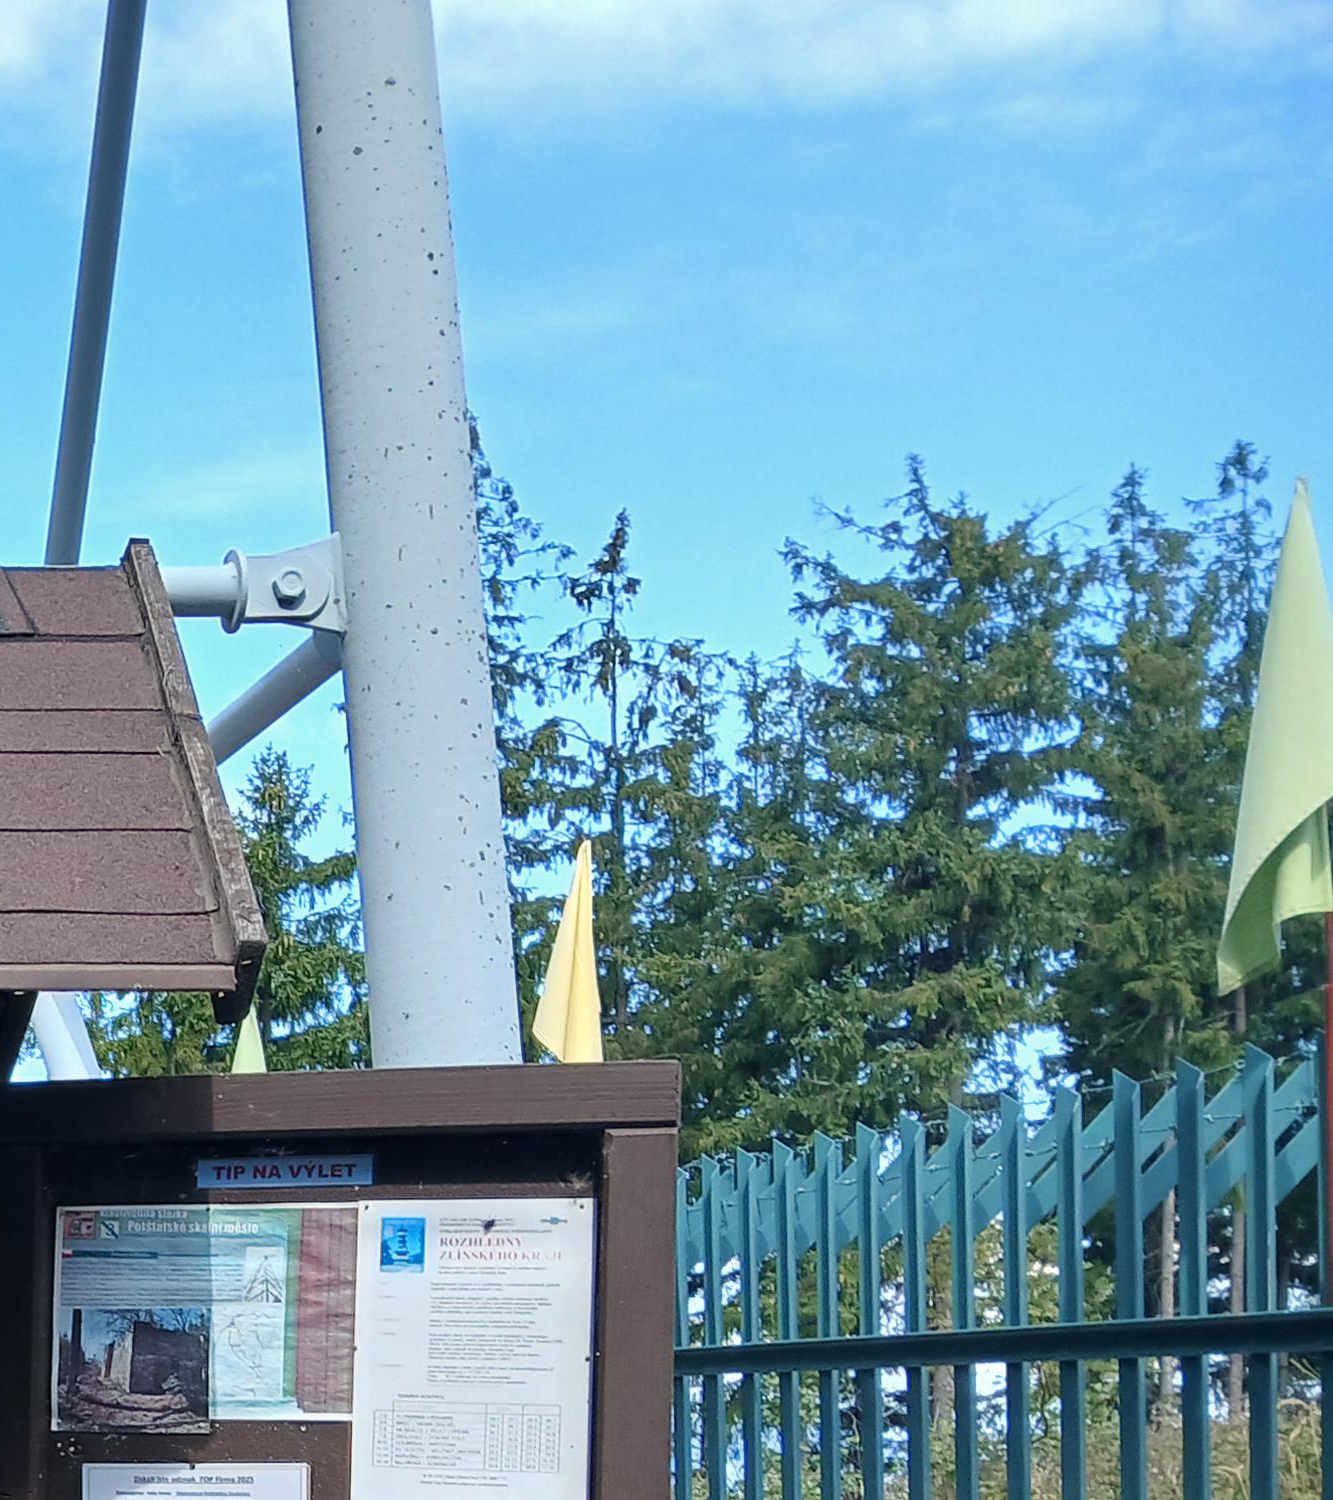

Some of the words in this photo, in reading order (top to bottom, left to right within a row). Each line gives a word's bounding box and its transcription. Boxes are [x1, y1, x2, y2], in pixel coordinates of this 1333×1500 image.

[213, 1164, 247, 1181] TIP
[251, 1163, 283, 1180] NA
[287, 1159, 357, 1180] VÝLET
